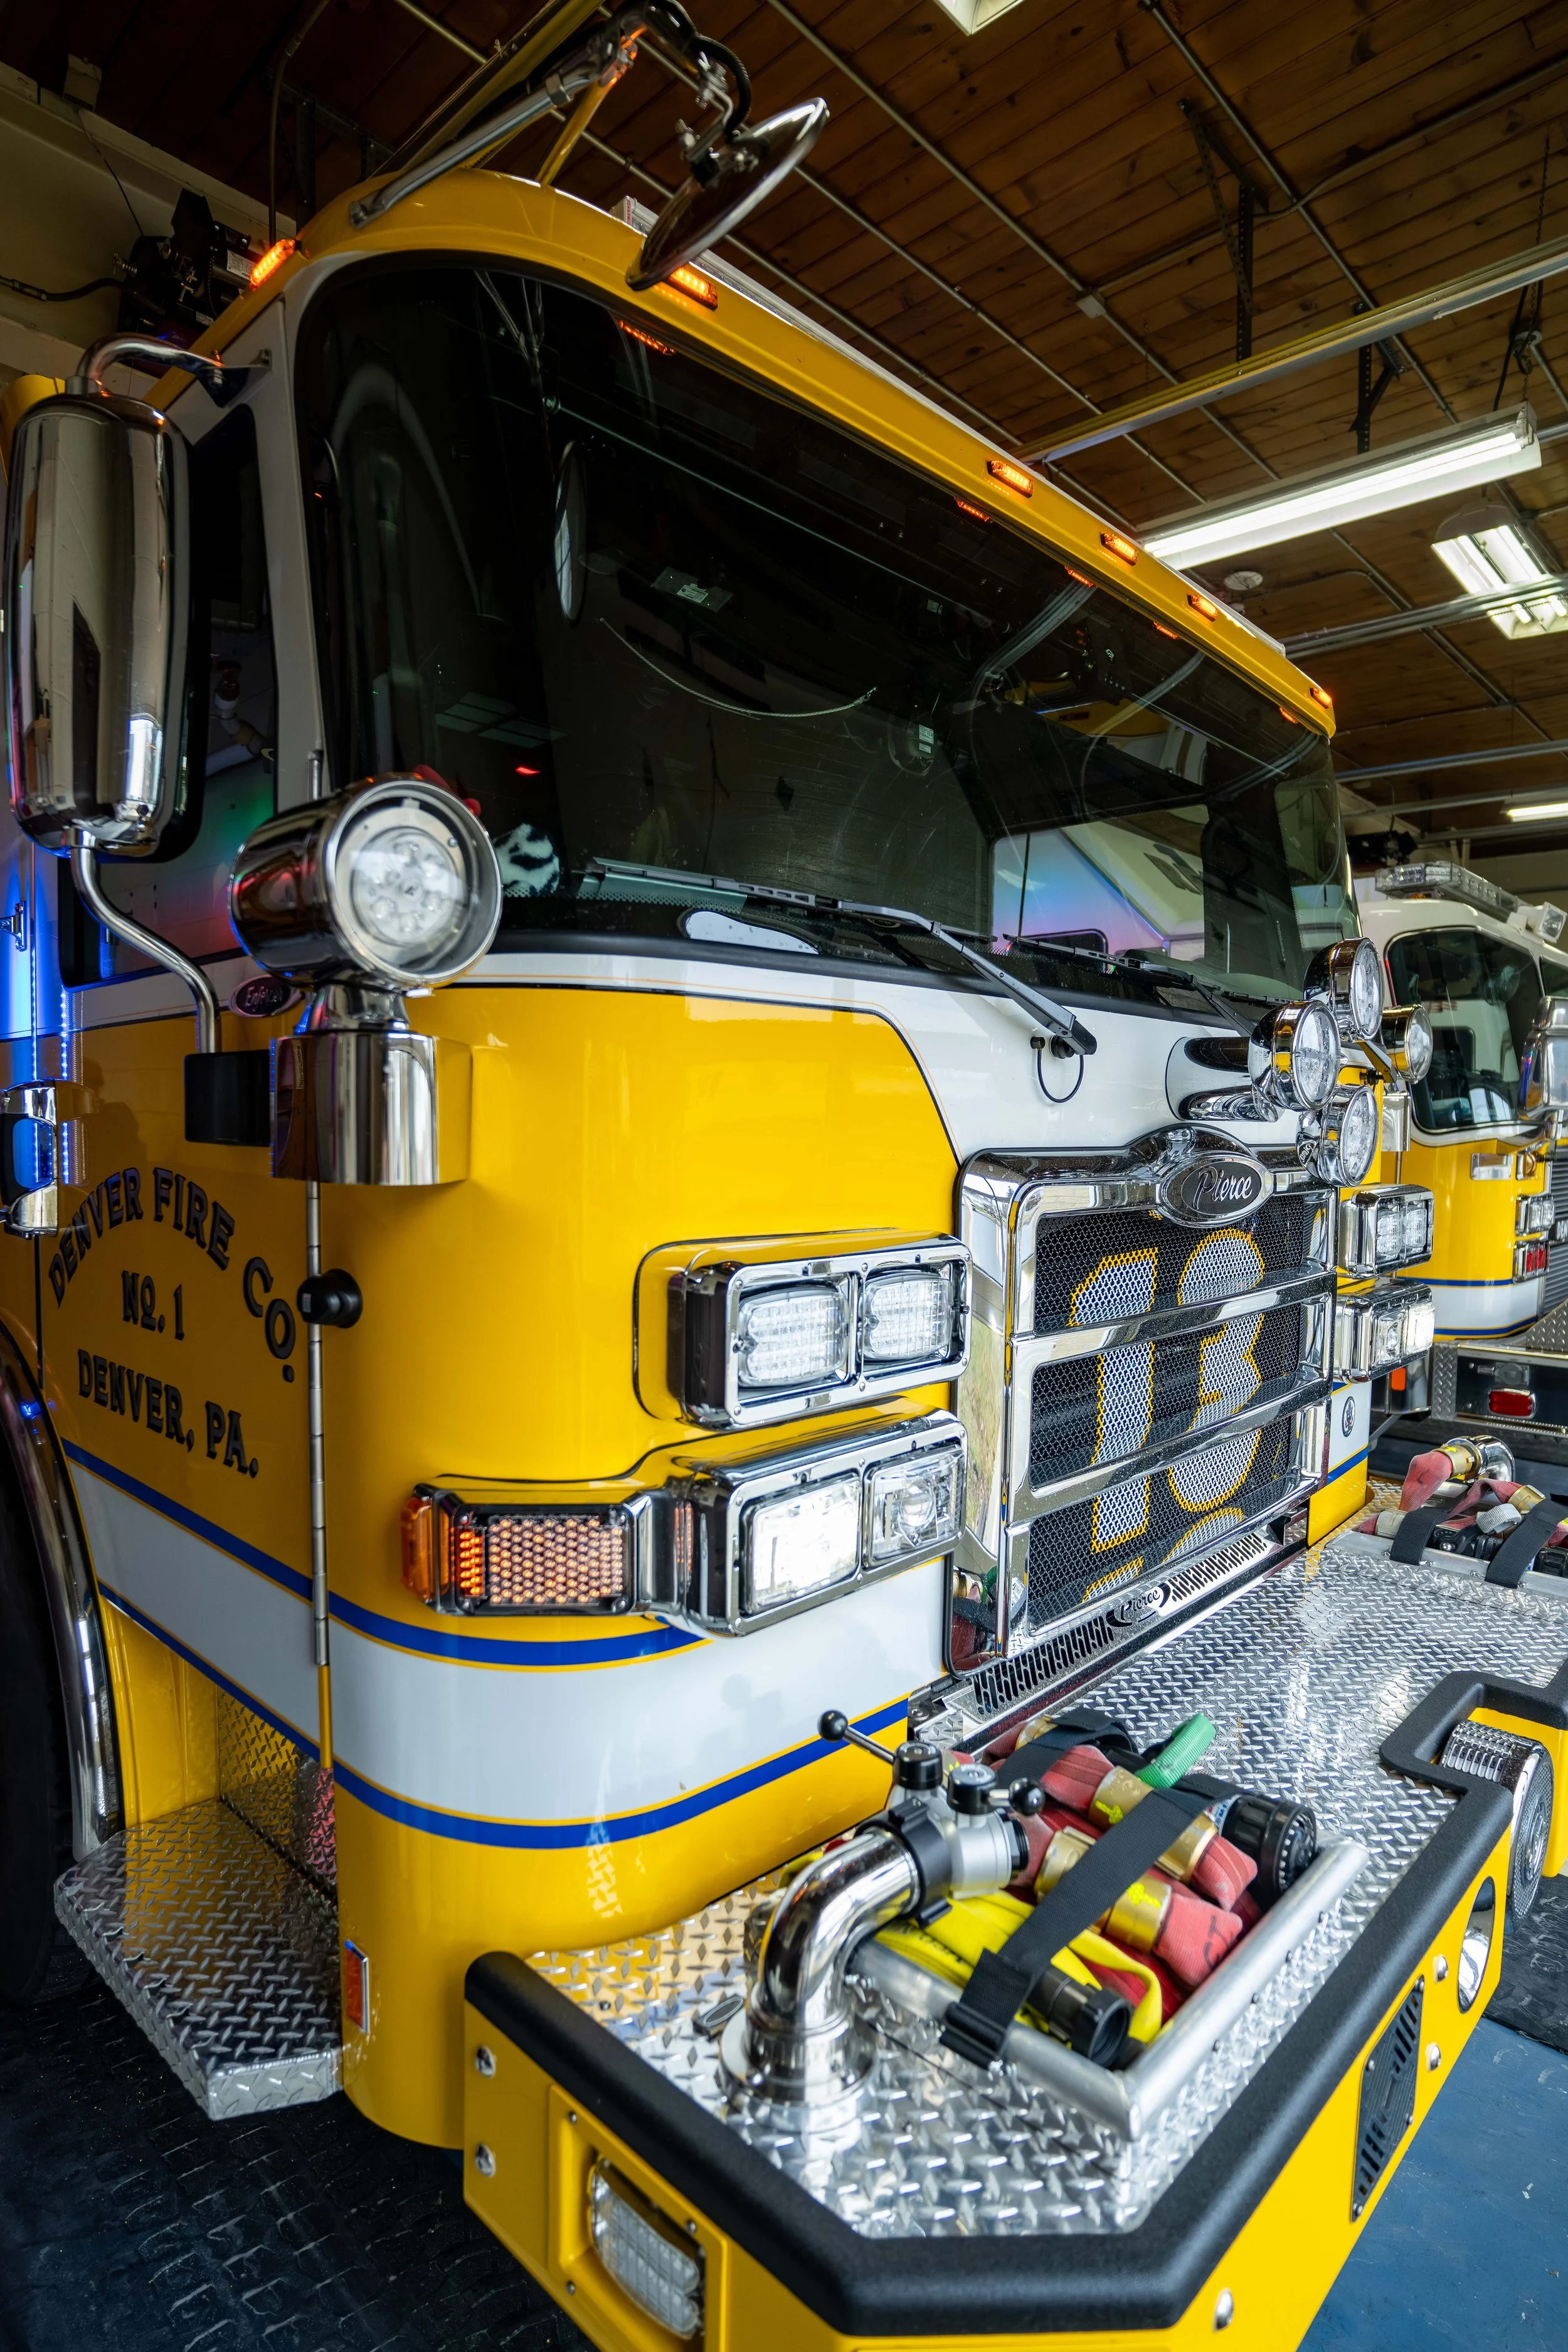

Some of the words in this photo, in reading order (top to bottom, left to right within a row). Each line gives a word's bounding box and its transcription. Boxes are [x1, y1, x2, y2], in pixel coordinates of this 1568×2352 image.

[1193, 1166, 1253, 1210] Pierce
[49, 1167, 144, 1308] DENVER
[153, 1167, 235, 1271] FIRE
[243, 1257, 295, 1383] CO.
[122, 1270, 165, 1333] NO.
[174, 1285, 184, 1340] 1
[78, 1348, 194, 1453] DENVER,
[205, 1401, 258, 1478] PA.
[1066, 1228, 1266, 1555] 13
[1121, 1589, 1160, 1621] Pierce
